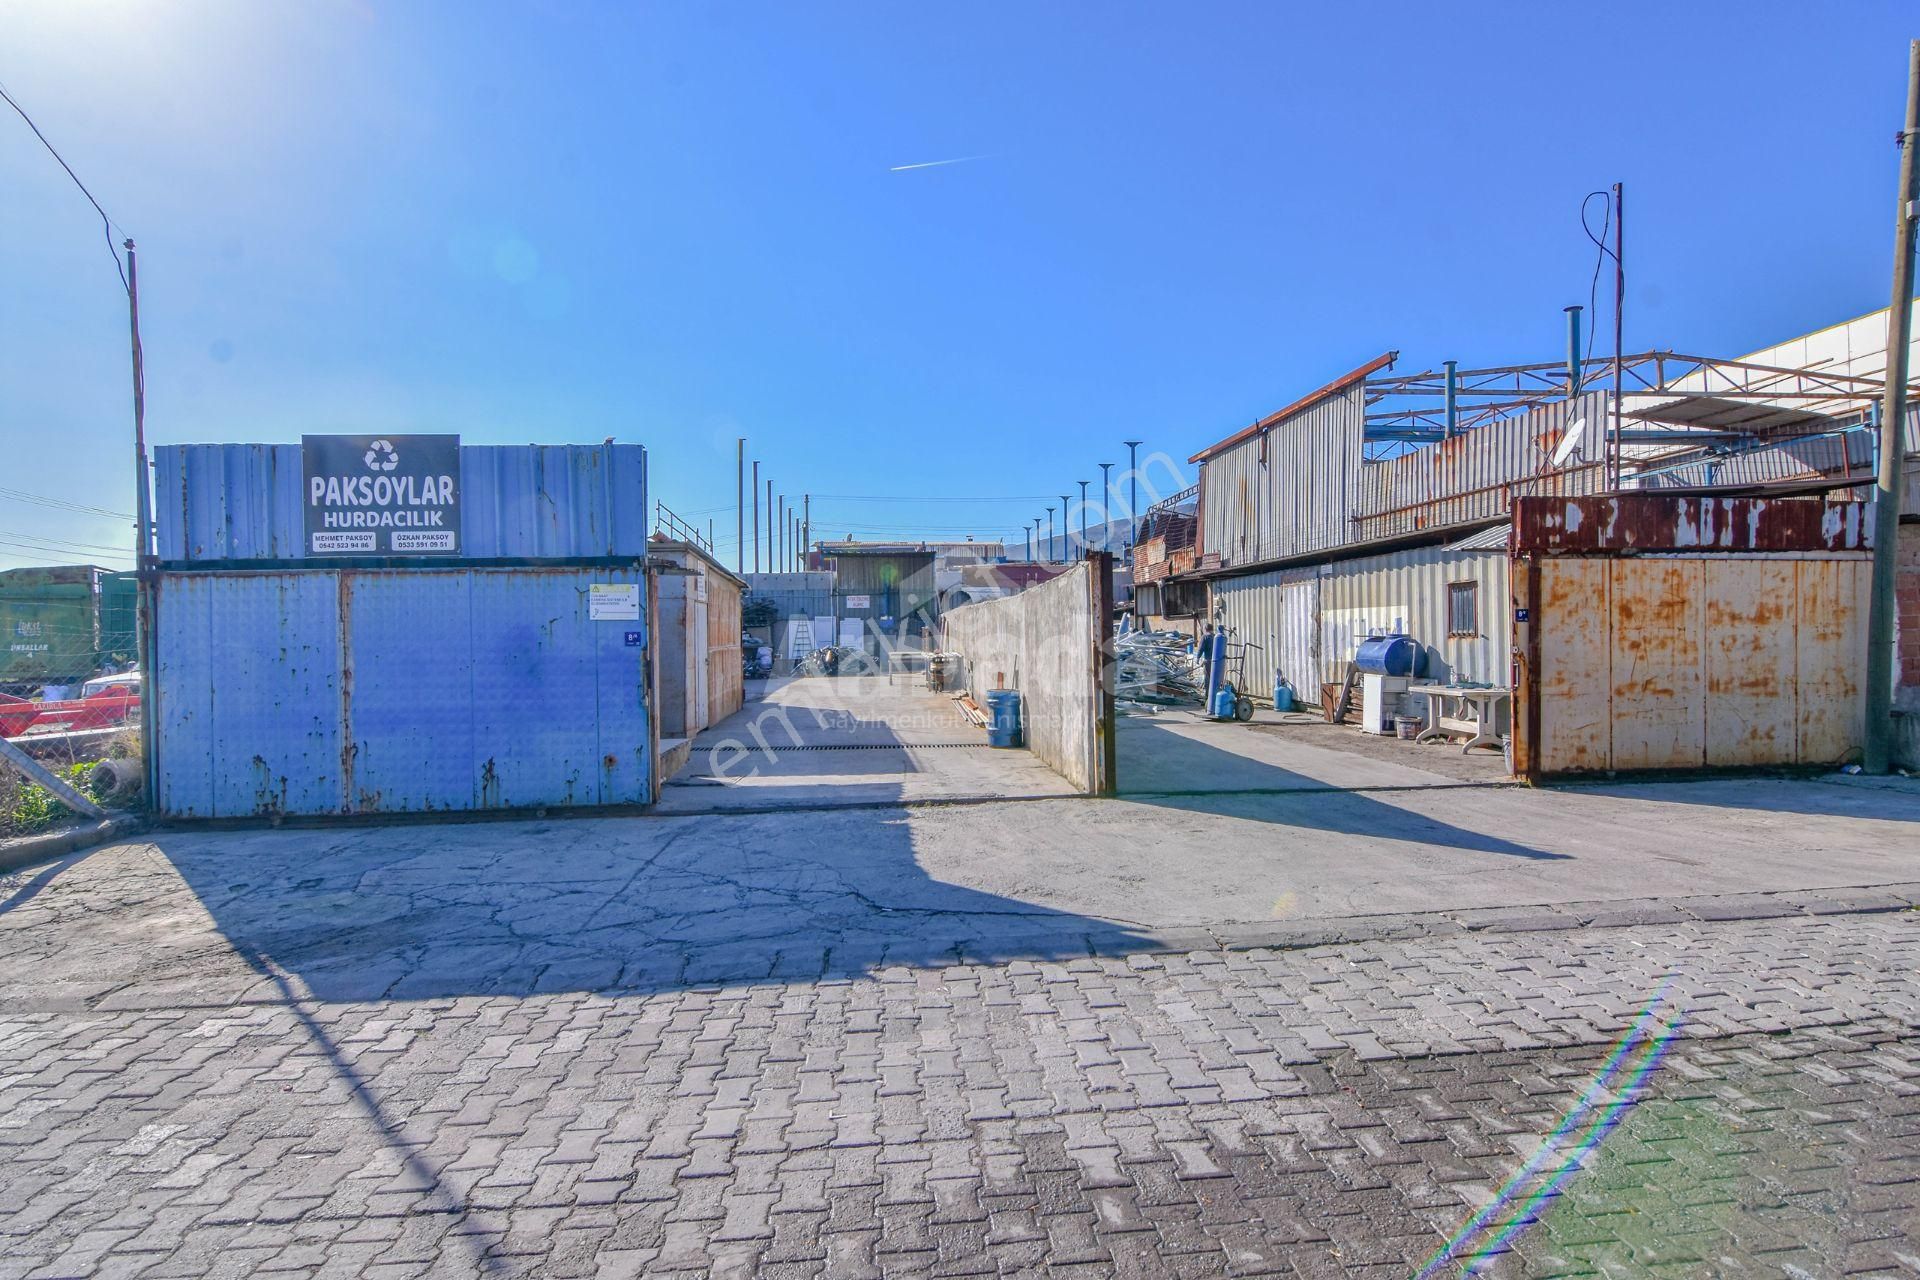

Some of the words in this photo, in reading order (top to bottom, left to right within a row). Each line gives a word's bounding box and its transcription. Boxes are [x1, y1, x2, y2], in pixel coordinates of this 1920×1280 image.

[311, 476, 453, 506] PAKSOYLAR
[324, 511, 443, 528] HURDACILIK
[397, 533, 420, 541] ÖZKAN
